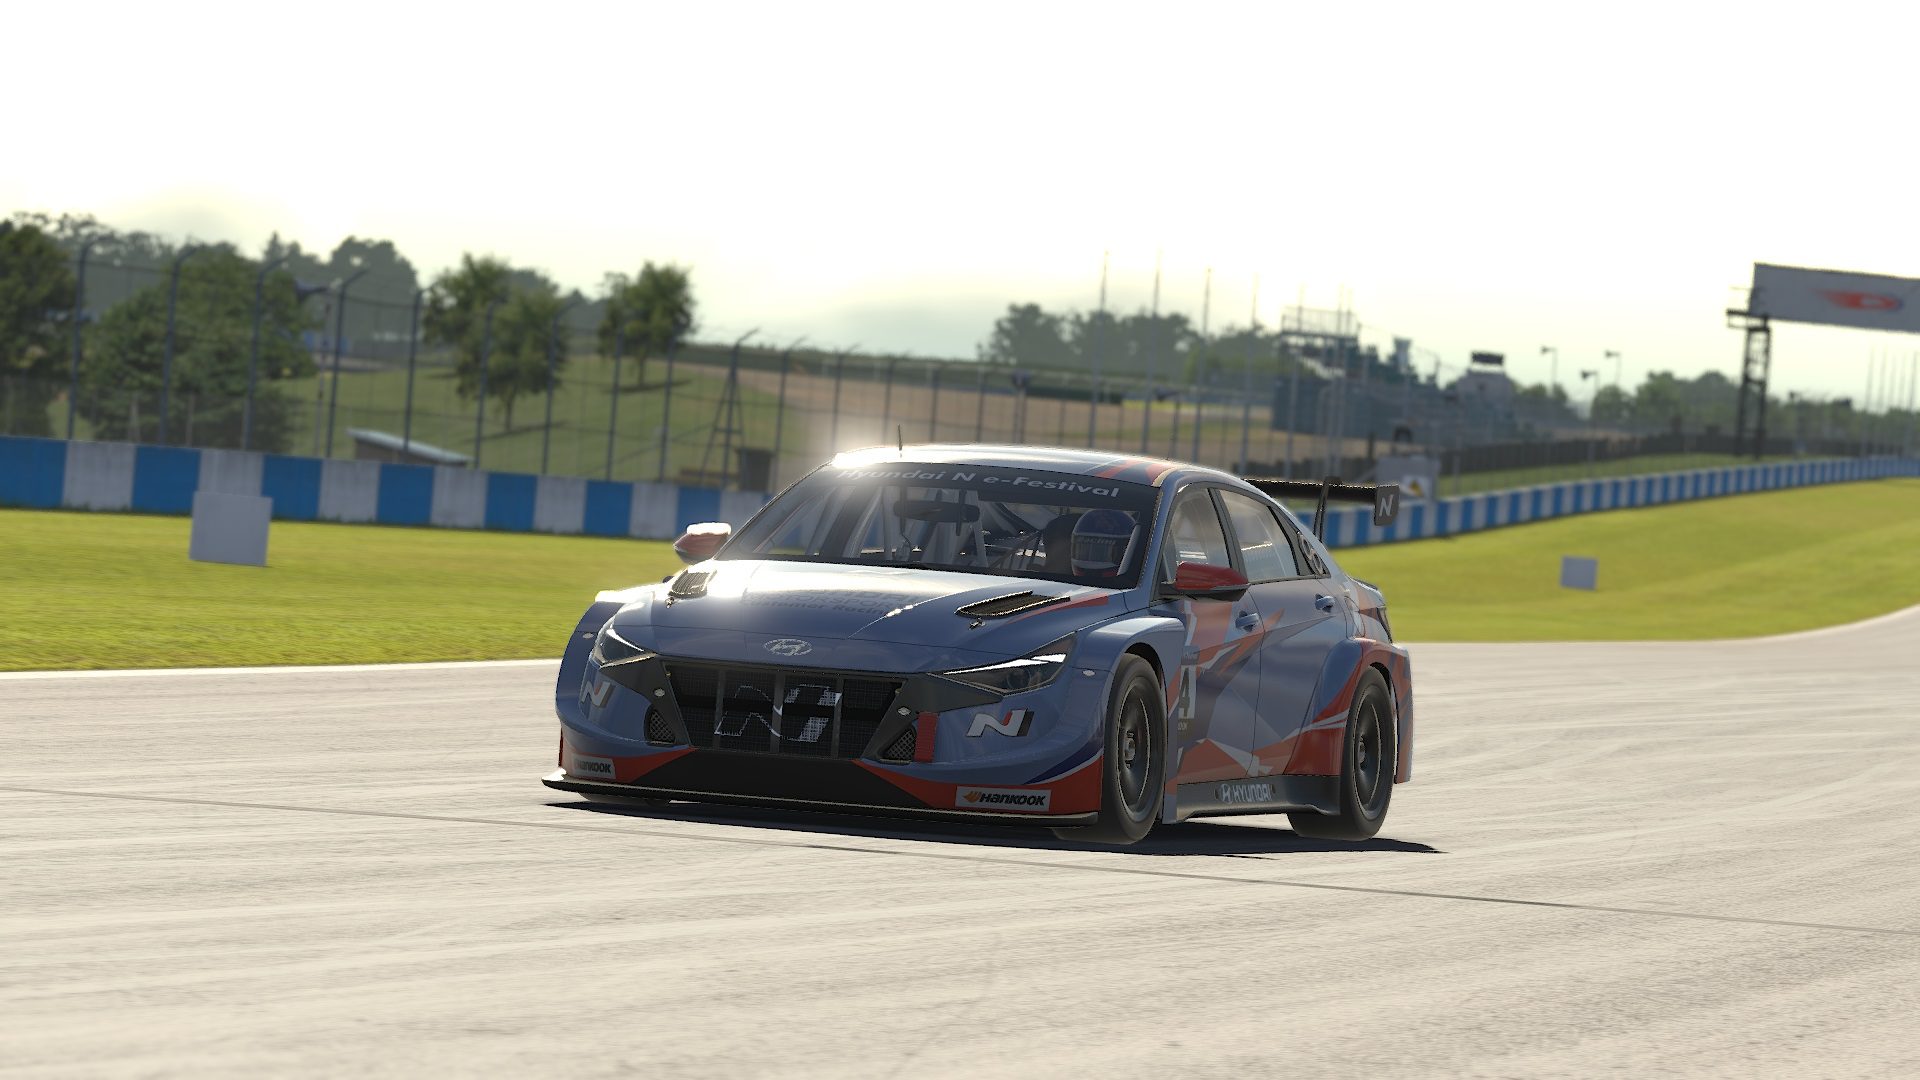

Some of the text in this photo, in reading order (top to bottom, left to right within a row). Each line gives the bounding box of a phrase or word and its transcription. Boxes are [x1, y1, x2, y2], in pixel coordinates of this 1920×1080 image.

[837, 468, 1119, 499] Hyundai N e-Festival
[1379, 494, 1393, 517] N
[966, 709, 1034, 737] N
[1232, 783, 1272, 802] HYUNDAI
